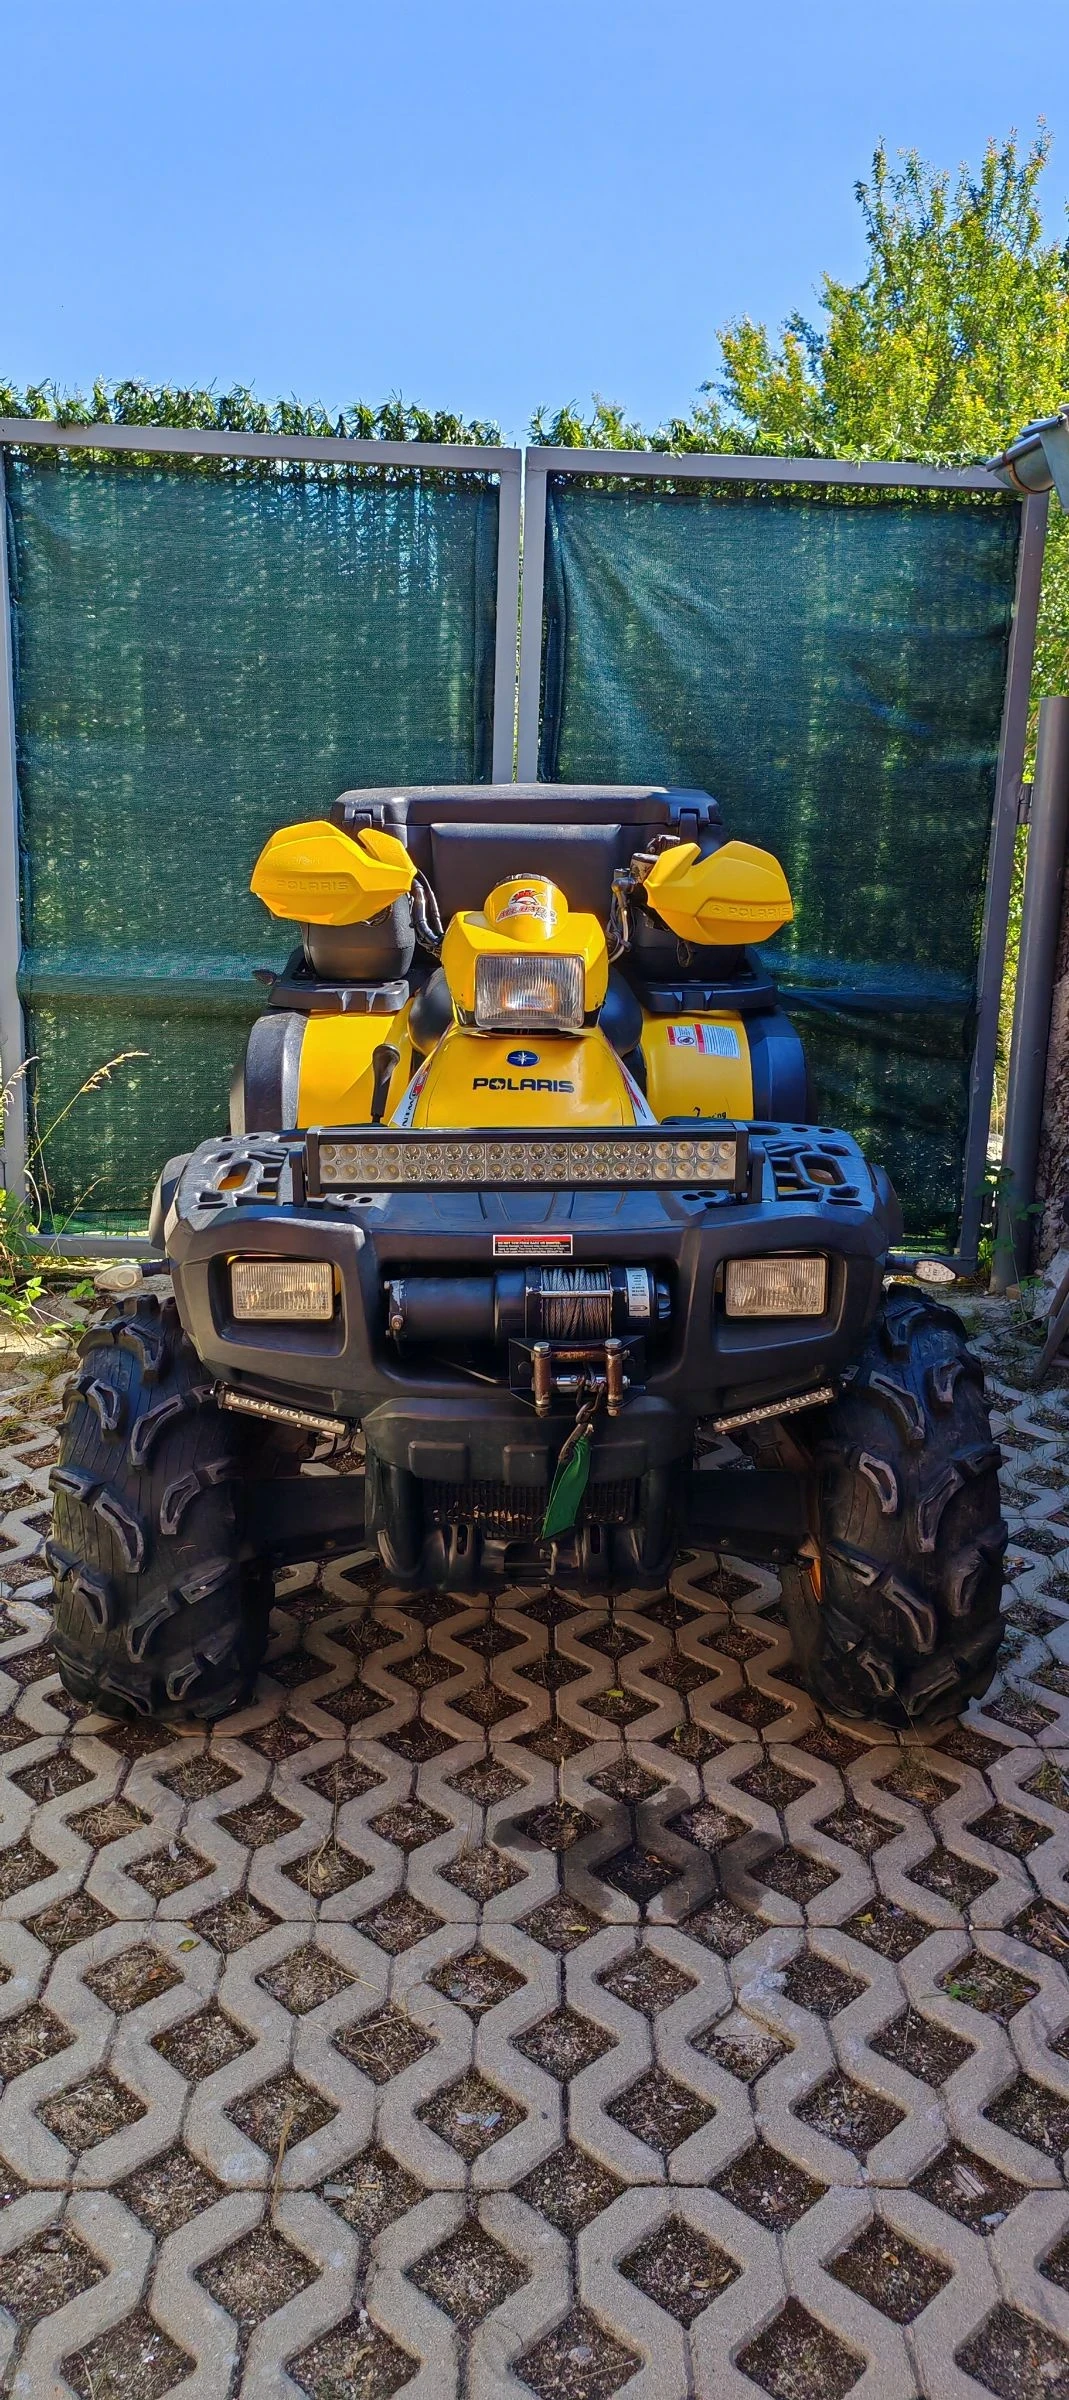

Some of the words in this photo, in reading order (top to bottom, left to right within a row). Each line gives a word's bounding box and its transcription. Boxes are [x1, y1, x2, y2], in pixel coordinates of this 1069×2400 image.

[276, 879, 349, 892] POLARIS
[728, 906, 791, 918] POLARIS
[472, 1077, 575, 1094] POLARIS
